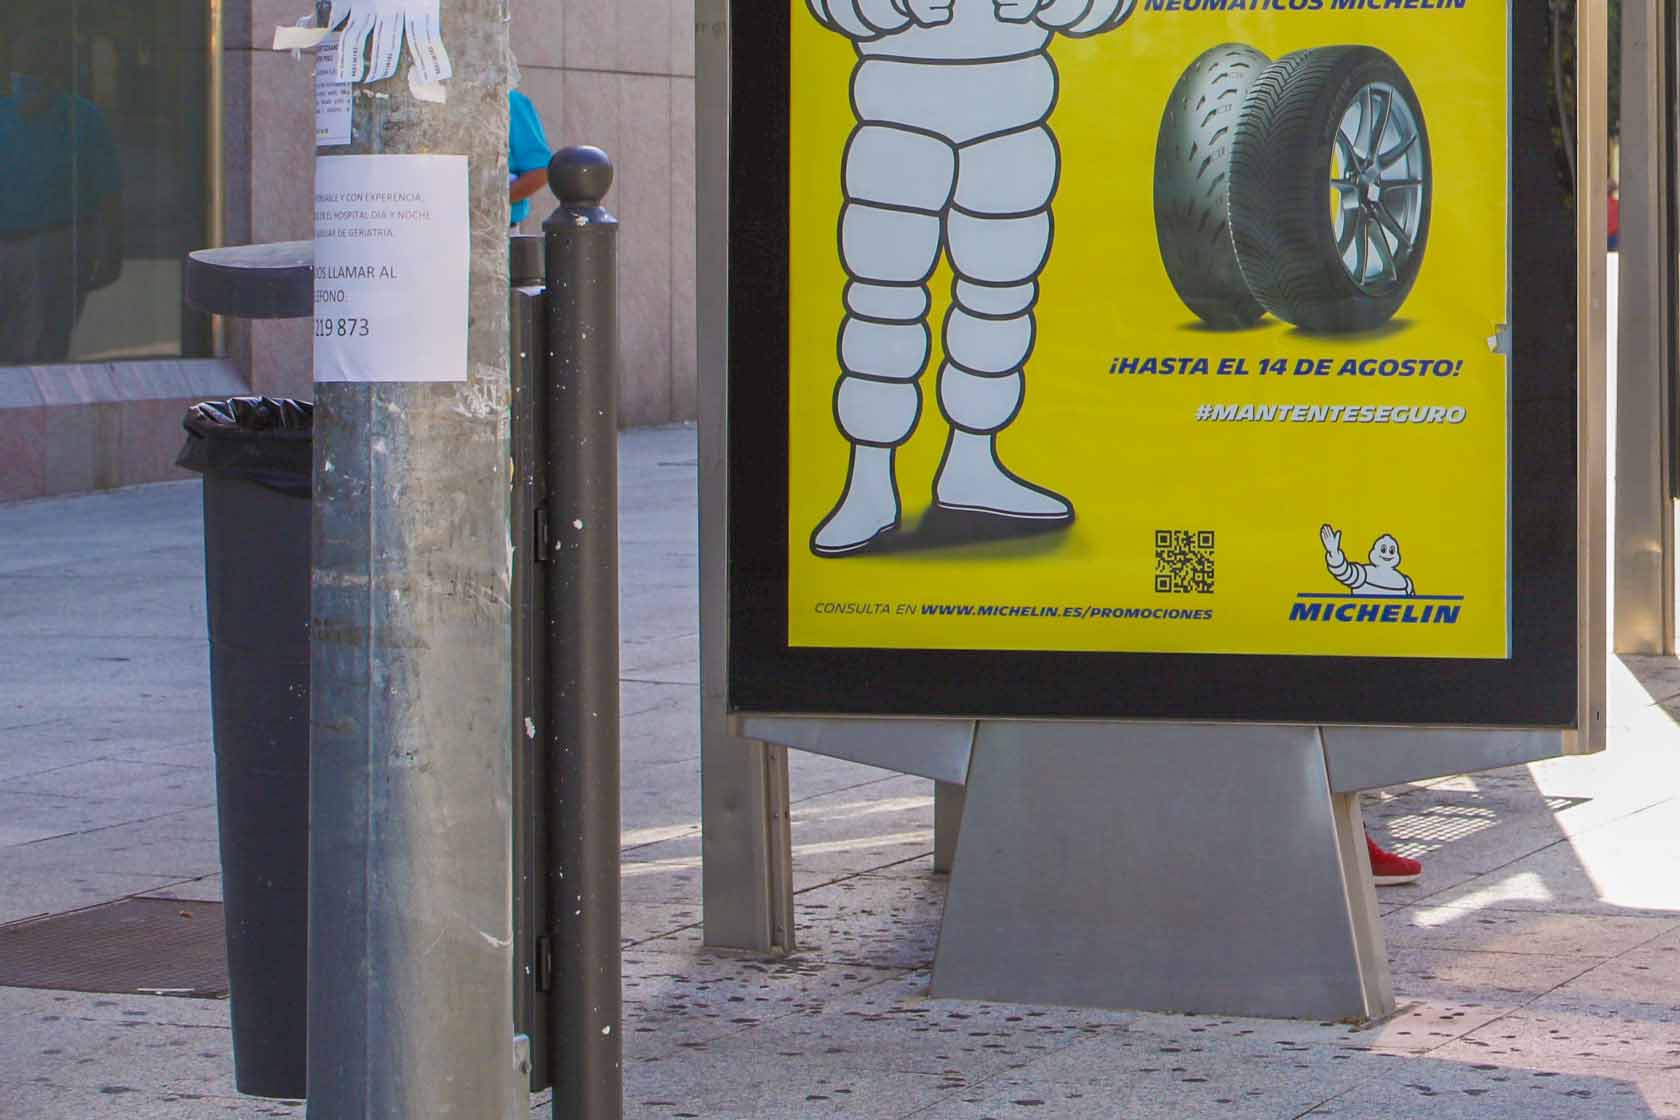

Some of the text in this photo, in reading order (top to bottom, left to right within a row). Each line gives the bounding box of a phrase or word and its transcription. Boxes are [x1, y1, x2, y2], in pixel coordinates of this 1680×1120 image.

[328, 265, 375, 279] LLAMAR
[379, 265, 398, 279] AL
[337, 318, 369, 337] 873
[1109, 357, 1464, 377] ¡HASTA EL 14 DE AGOSTO!
[1195, 402, 1467, 425] #MANTENTESEGURO
[814, 602, 1214, 621] CONSULTA EN WWW.MICHELIN.ES/PROMOCIONES
[1289, 602, 1462, 624] MICHELIN
